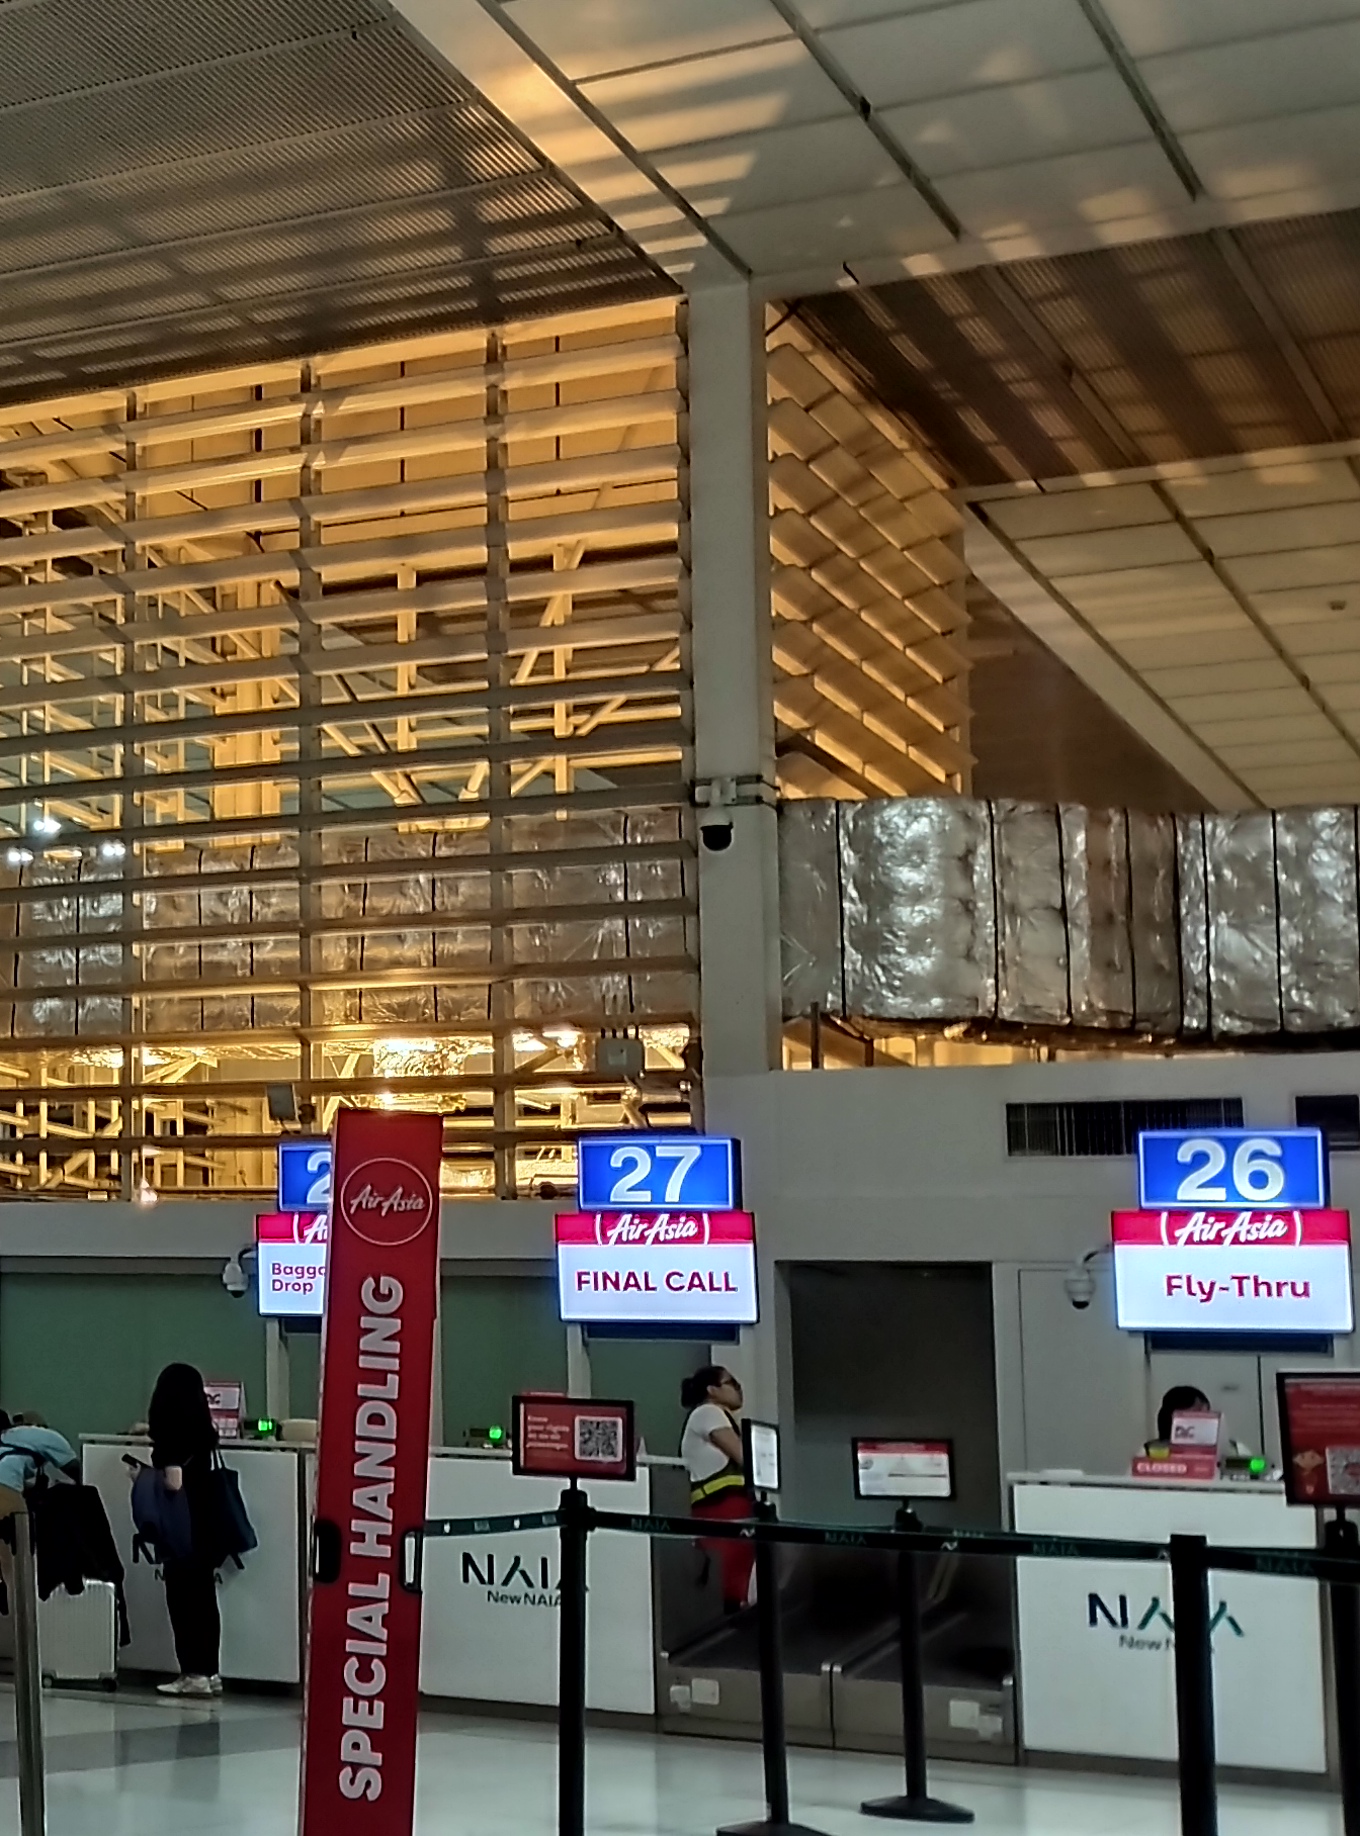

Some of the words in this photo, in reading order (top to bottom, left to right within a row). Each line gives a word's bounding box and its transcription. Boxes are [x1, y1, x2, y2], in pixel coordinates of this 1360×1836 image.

[306, 1151, 331, 1204] 2
[610, 1146, 701, 1202] 27
[1177, 1138, 1285, 1201] 26
[349, 1183, 426, 1217] AirAsia
[607, 1213, 698, 1246] AirAsia
[1174, 1211, 1288, 1246] AirAsia
[272, 1279, 314, 1294] Drop
[576, 1271, 657, 1292] FINAL
[664, 1271, 739, 1292] CALL
[1165, 1274, 1310, 1303] Fly-Thru
[349, 1275, 404, 1558] HANDLING
[1136, 1461, 1187, 1475] CLOSED
[630, 1517, 671, 1532] NAIA
[824, 1531, 868, 1547] NAIA
[462, 1552, 589, 1591] NAI
[487, 1590, 521, 1605] New
[1088, 1592, 1245, 1638] NAA
[1119, 1634, 1163, 1651] New
[338, 1572, 391, 1802] SPECIAL
